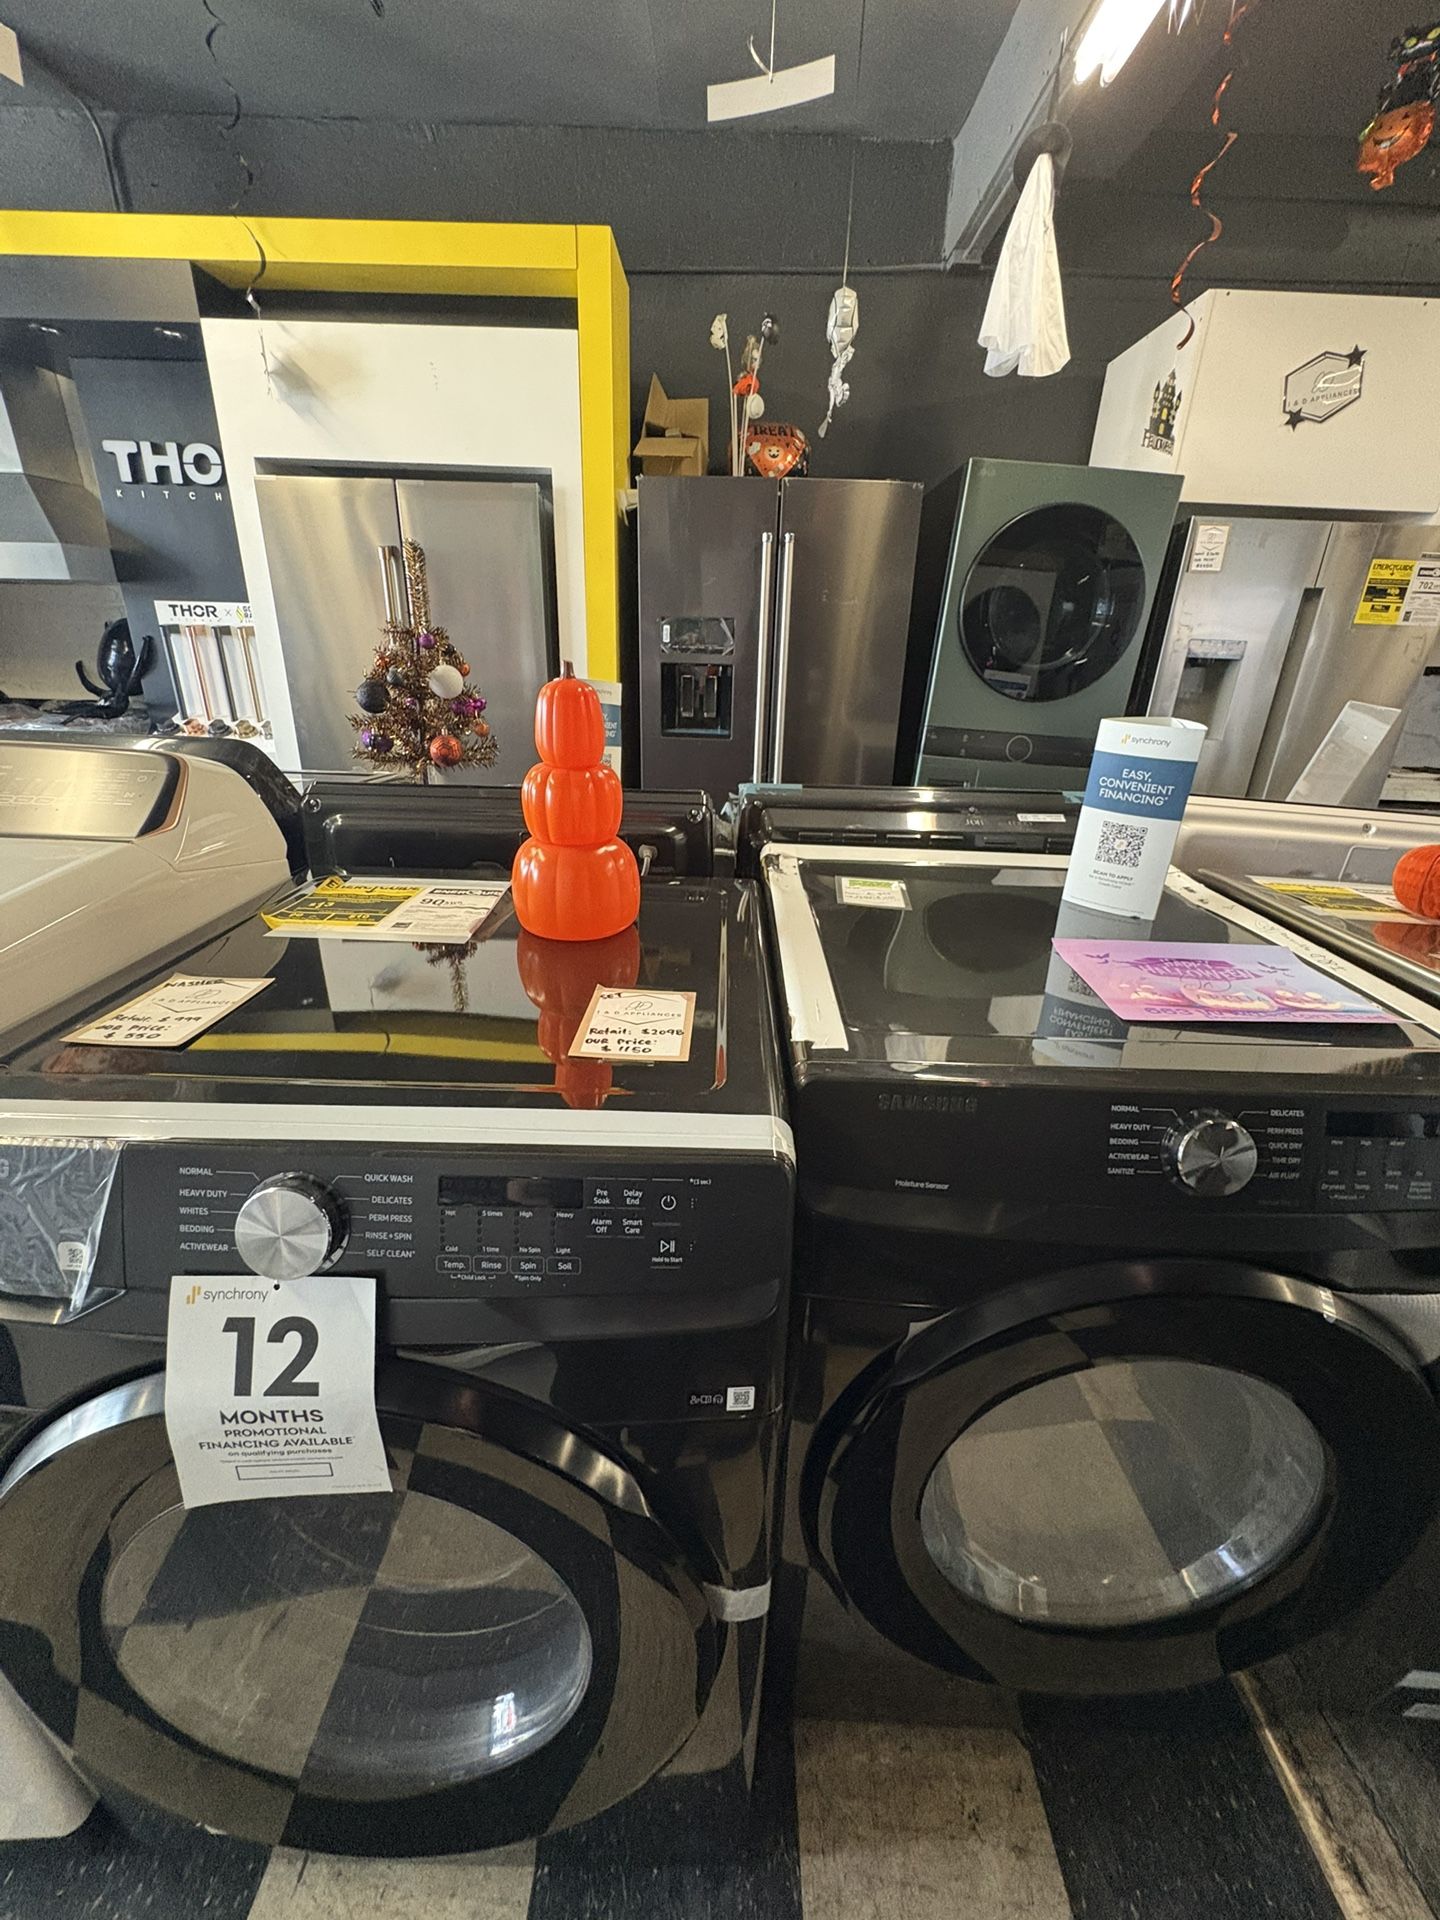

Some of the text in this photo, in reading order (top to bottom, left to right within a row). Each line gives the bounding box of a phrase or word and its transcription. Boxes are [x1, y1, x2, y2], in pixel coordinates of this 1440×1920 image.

[1310, 388, 1360, 402] APPLIANCES
[102, 439, 224, 486] THO
[116, 489, 225, 502] KITCH
[1418, 581, 1434, 590] 702
[168, 604, 219, 618] THOR
[1131, 737, 1172, 748] synchrony
[1122, 768, 1152, 782] EASY,
[1099, 777, 1175, 796] CONVENIENT
[1117, 873, 1134, 881] APPLY
[420, 898, 445, 906] 90
[600, 992, 622, 1000] SET
[589, 1027, 685, 1036] Retail: $2098
[878, 1092, 979, 1113] SAMSUNG
[1111, 1105, 1140, 1113] NORMAL
[1270, 1109, 1305, 1117] DELICATES
[1110, 1123, 1133, 1131] HEAVY
[1267, 1127, 1304, 1136] PERM PRESS
[1109, 1138, 1139, 1146] BEDDING
[1268, 1142, 1303, 1150] QUICK DRY
[1108, 1153, 1150, 1161] ACTIVEWEAR
[1272, 1156, 1301, 1164] TIME DRY
[179, 1167, 214, 1176] NORMAL
[1268, 1172, 1300, 1180] AIR FLUFF
[364, 1174, 413, 1183] QUICK WASH
[895, 1179, 950, 1190] Moisture Sensor
[179, 1189, 228, 1198] HEAVY DUTY
[623, 1189, 643, 1198] Delay
[371, 1196, 413, 1205] DELICATES
[179, 1207, 209, 1215] WHITES
[556, 1211, 575, 1219] Heavy
[368, 1214, 413, 1223] PERM PRESS
[622, 1218, 643, 1226] Smart
[179, 1225, 215, 1233] BEDDING
[365, 1232, 388, 1240] RINSE
[394, 1233, 412, 1241] SPIN
[180, 1243, 229, 1251] ACTIVEWEAR
[366, 1249, 385, 1257] SELF
[443, 1260, 466, 1269] Temp.
[481, 1261, 502, 1269] Rinse
[519, 1262, 537, 1270] Spin
[557, 1262, 573, 1270] Soil
[203, 1287, 269, 1303] synchrony
[222, 1315, 320, 1397] 12
[219, 1409, 324, 1425] MONTHS
[224, 1426, 327, 1438] PROMOTIONAL
[199, 1438, 280, 1450] FINANCING
[241, 1449, 285, 1457] qualifying
[286, 1448, 333, 1456] purchases
